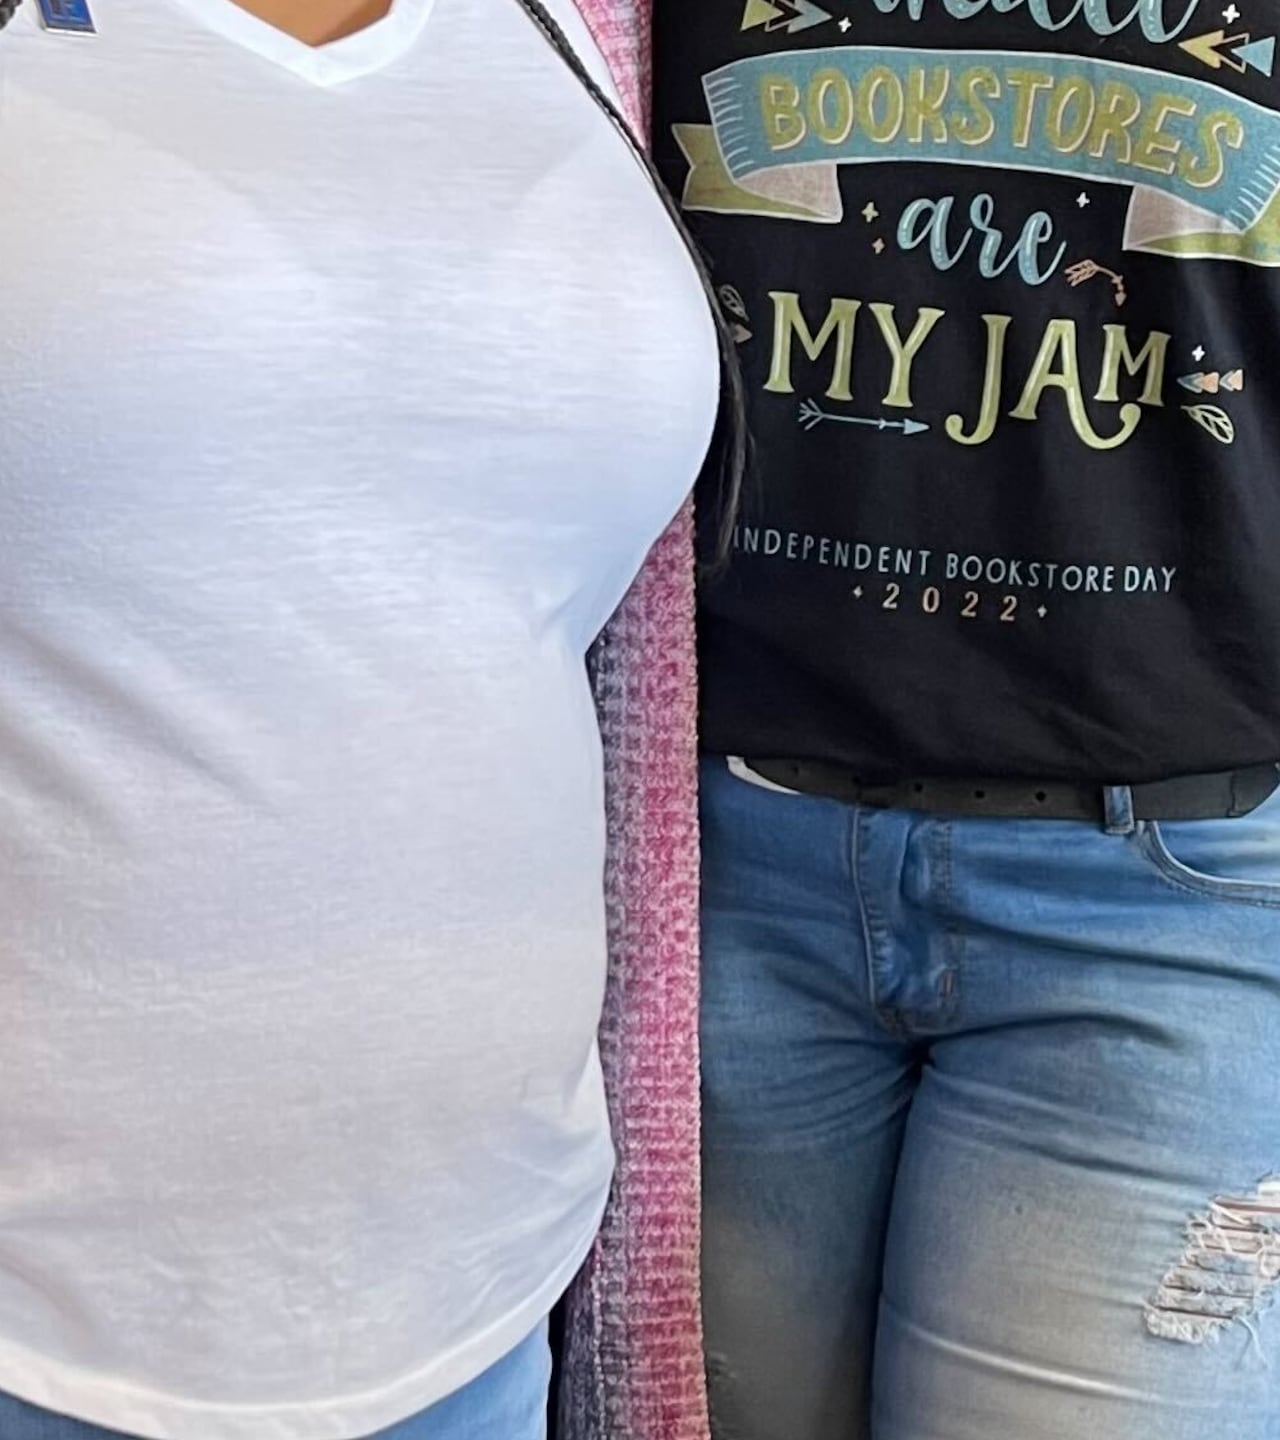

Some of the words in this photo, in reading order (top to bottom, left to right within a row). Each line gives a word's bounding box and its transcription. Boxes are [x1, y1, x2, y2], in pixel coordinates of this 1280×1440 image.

[760, 65, 1245, 188] BOOKSTORES
[895, 192, 1067, 286] are
[762, 290, 946, 409] MY
[944, 313, 1172, 451] JAM
[732, 525, 932, 576] INDEPENDENT
[944, 552, 1115, 594] BOOKSTORE
[1123, 565, 1177, 594] DAY
[882, 582, 1019, 623] 2022
